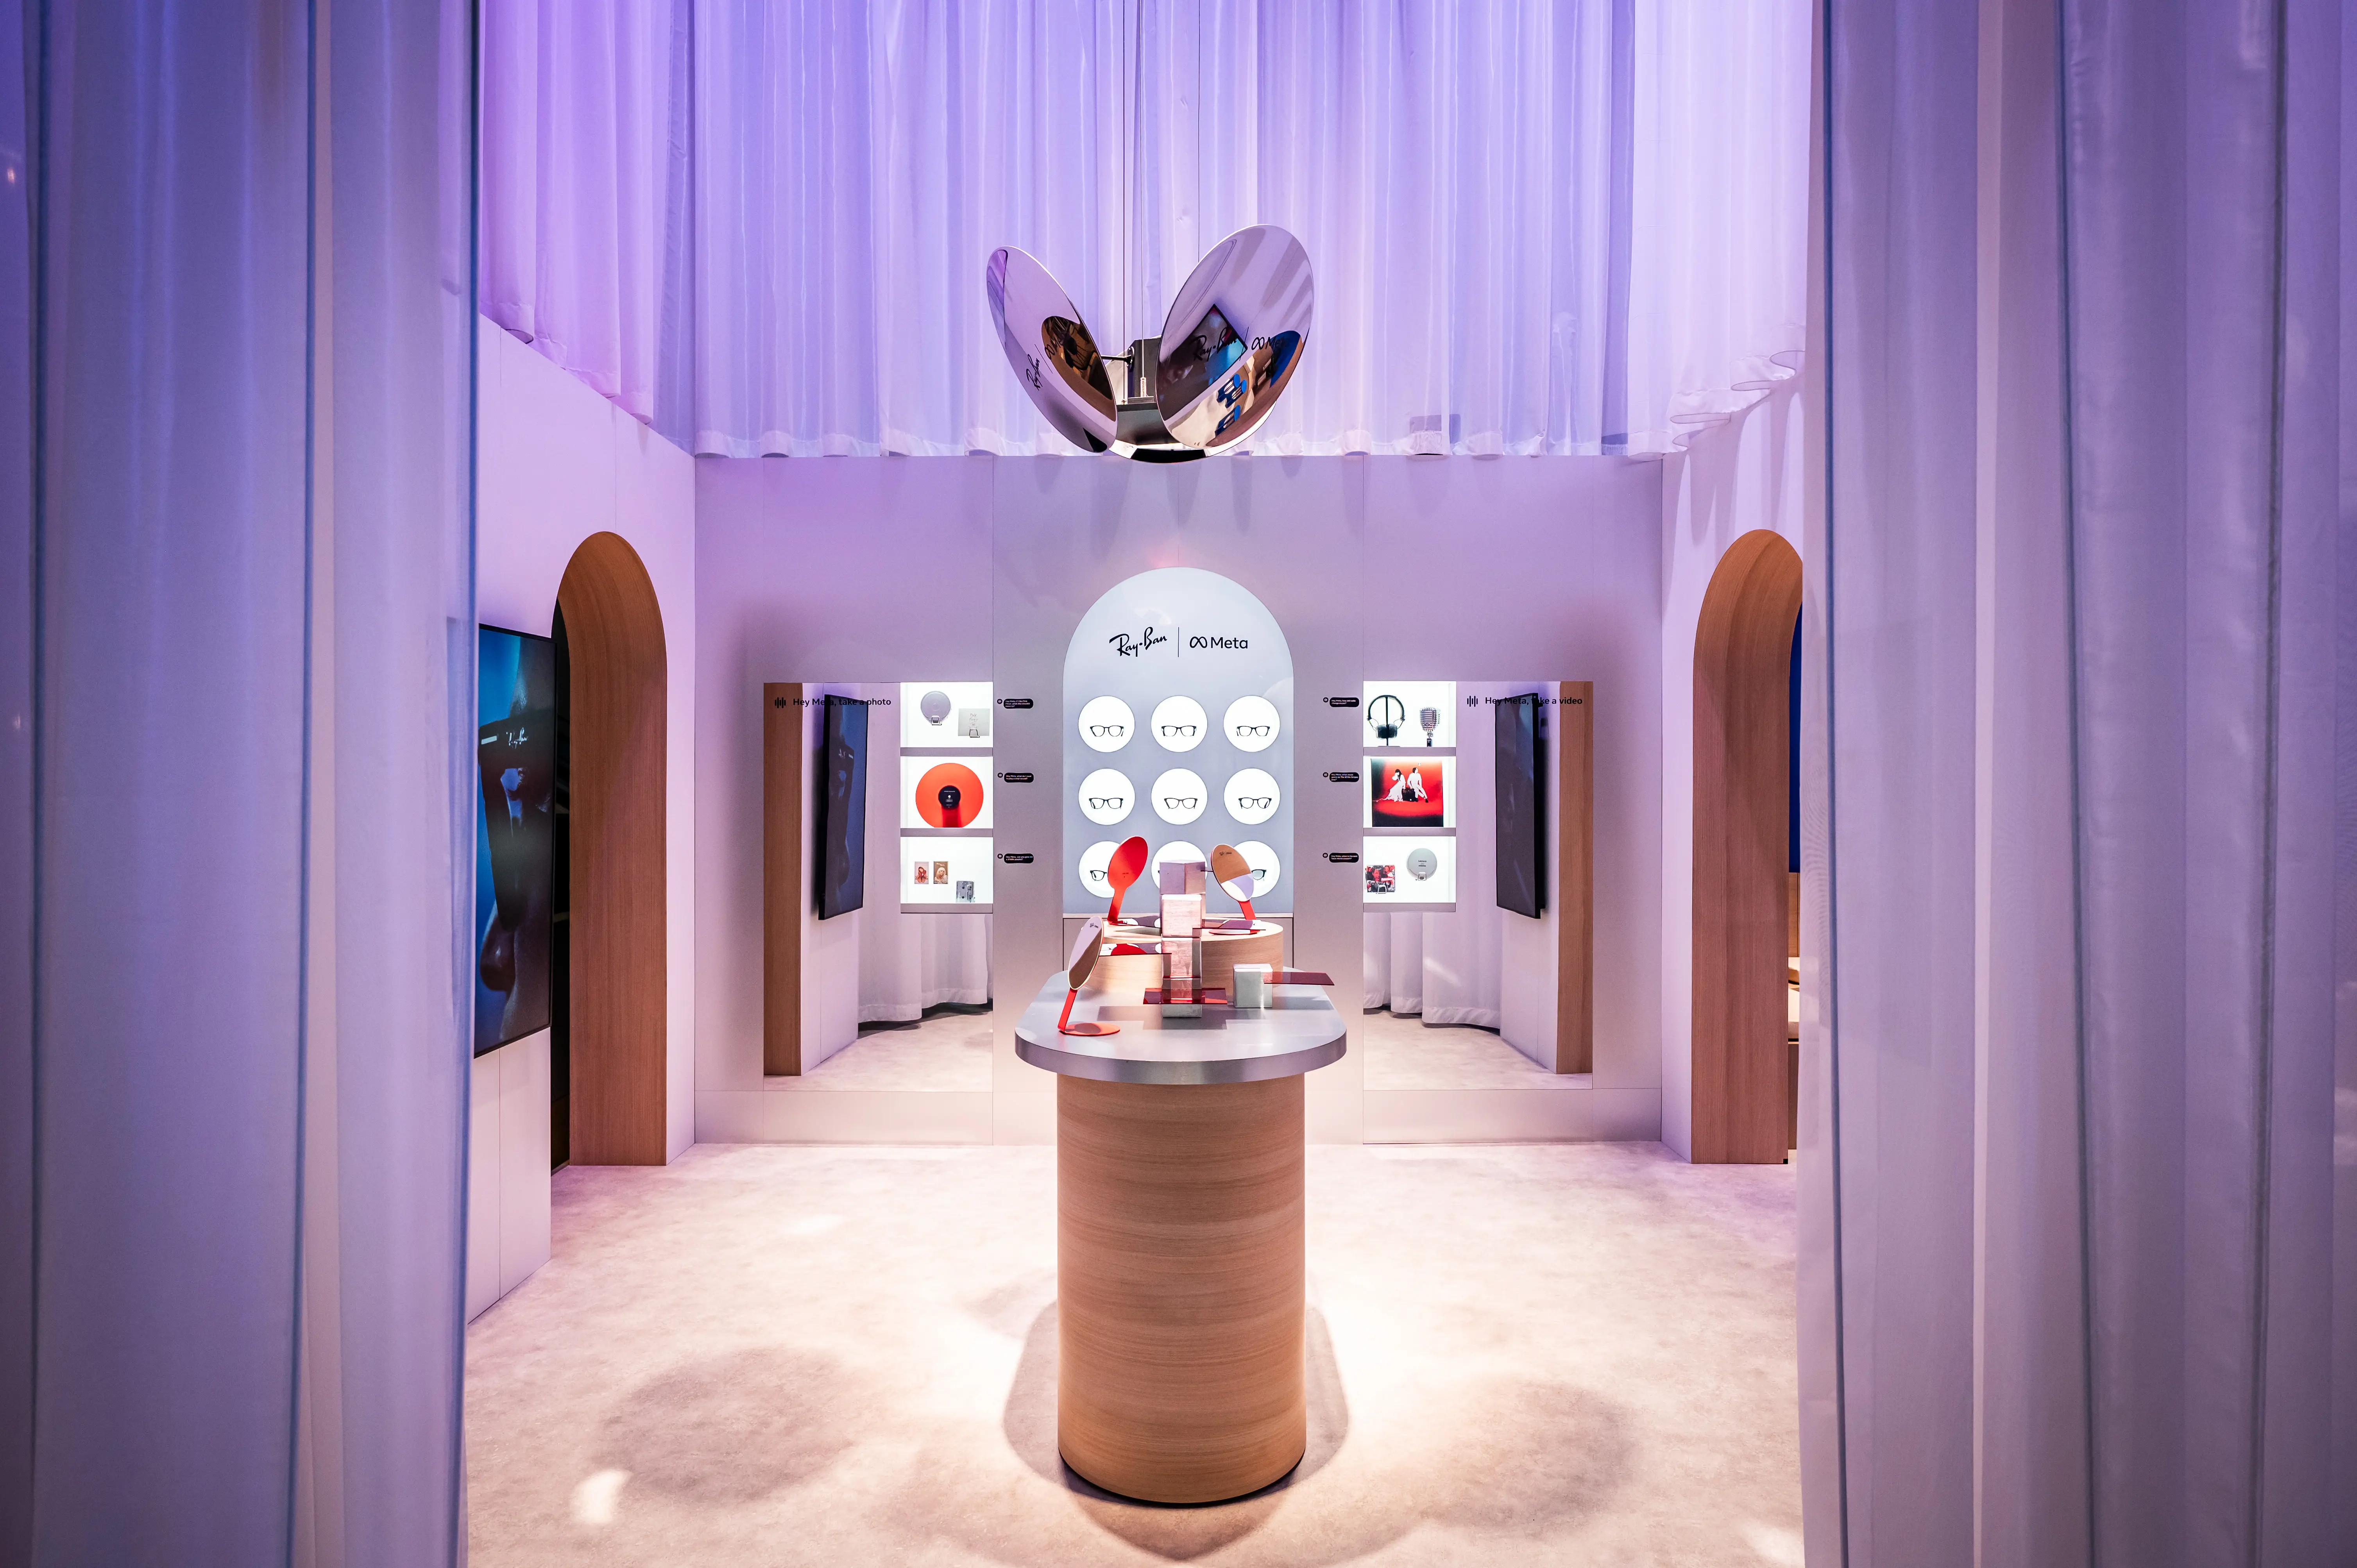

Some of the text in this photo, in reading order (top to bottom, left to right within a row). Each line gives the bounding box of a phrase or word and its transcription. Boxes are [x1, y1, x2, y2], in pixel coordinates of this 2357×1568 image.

[1211, 637, 1248, 649] Meta
[793, 698, 810, 707] Hey
[812, 698, 837, 706] Mea,
[867, 698, 891, 707] photo
[1485, 697, 1502, 706] Hey
[1505, 697, 1529, 706] Meta,
